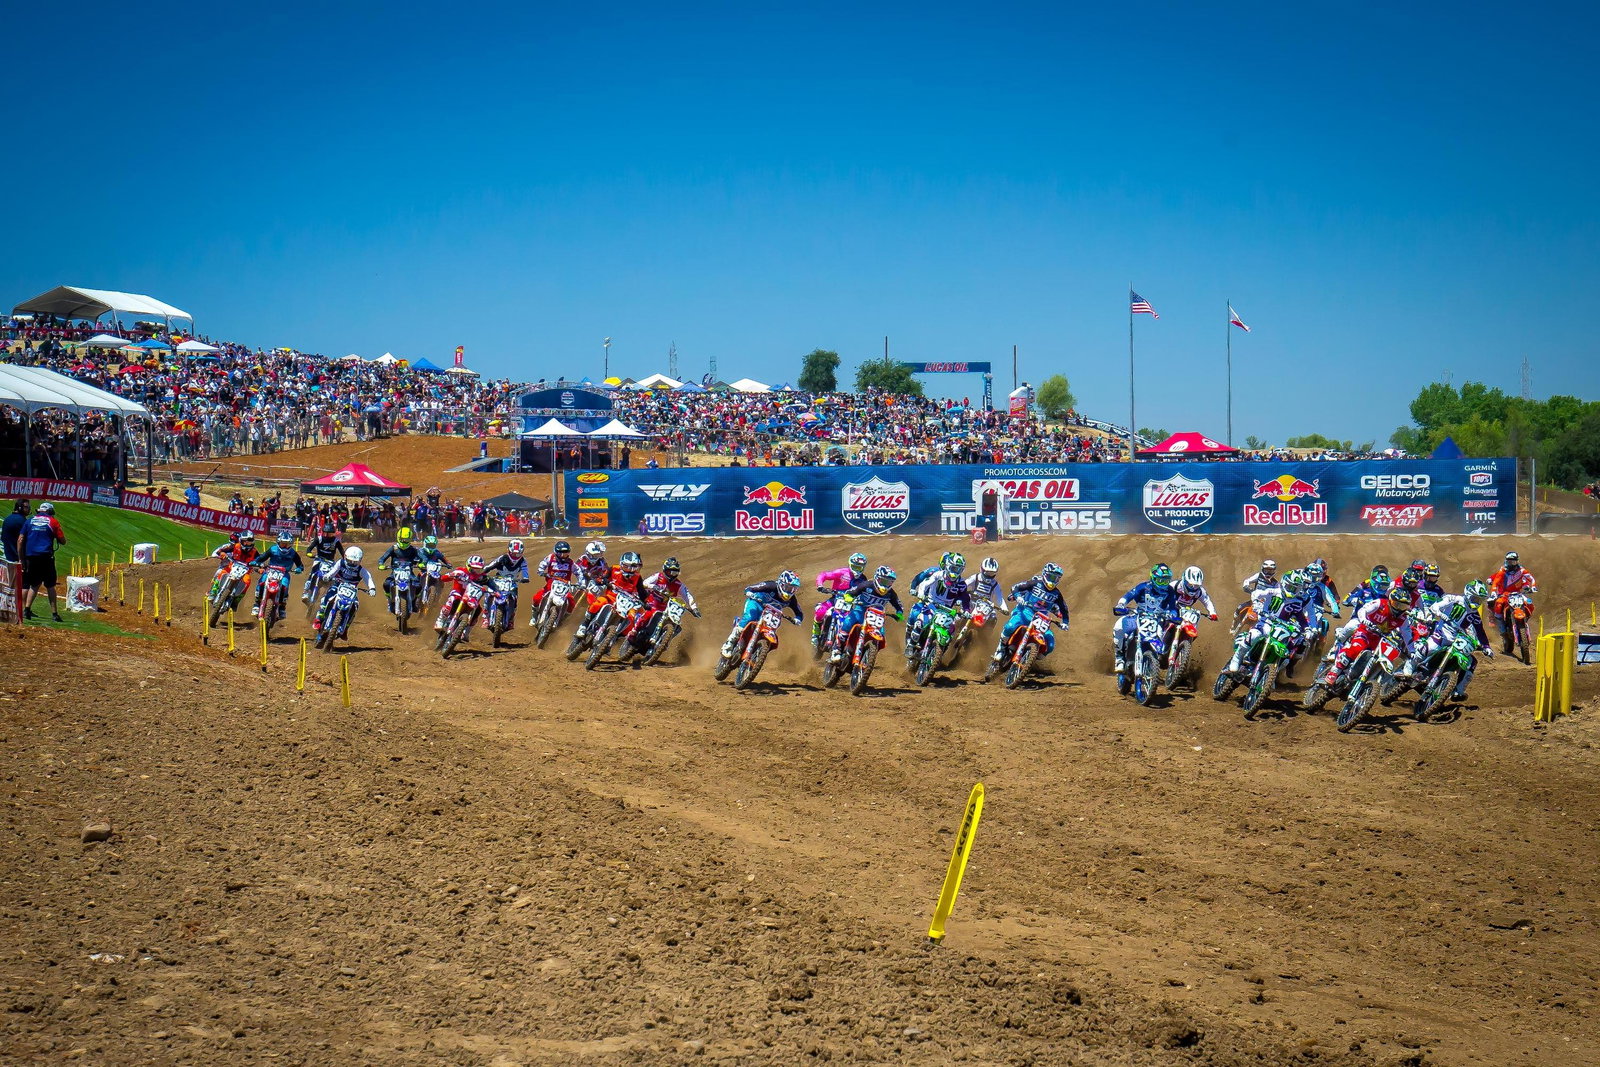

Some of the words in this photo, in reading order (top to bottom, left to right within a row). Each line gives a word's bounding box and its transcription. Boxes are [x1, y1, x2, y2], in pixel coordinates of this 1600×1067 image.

[924, 362, 952, 372] LUCAS
[954, 362, 969, 372] OIL
[984, 468, 1067, 476] PROMOTOCROSS.COM
[11, 480, 34, 495] LUCAS
[1360, 474, 1431, 489] GEICO
[47, 482, 76, 498] LUCAS
[76, 485, 89, 500] OIL
[648, 484, 711, 497] FLY
[976, 480, 1041, 499] CAS
[1044, 480, 1077, 498] OIL
[1375, 487, 1430, 499] Motorcycle
[124, 494, 150, 511] LUCAS
[151, 499, 165, 513] OIL
[850, 495, 905, 509] LUCAS
[1151, 492, 1210, 507] LUCAS
[168, 502, 198, 520] LUCAS
[200, 509, 215, 524] OIL
[735, 509, 775, 531] Red
[776, 508, 814, 531] Bull
[846, 512, 861, 520] OIL
[862, 511, 906, 519] PRODUCTS
[1165, 509, 1210, 517] PRODUCTS
[1244, 503, 1285, 526] Red
[1287, 502, 1328, 525] Bull
[1396, 506, 1433, 518] ATV
[219, 513, 249, 531] LUCAS
[250, 517, 265, 532] OIL
[644, 513, 706, 533] WPS
[868, 521, 886, 529] INC.
[941, 510, 1112, 530] MOOCROSS
[1171, 519, 1188, 527] INC.
[1371, 518, 1395, 527] ALL
[1396, 518, 1418, 526] OUT
[1032, 617, 1050, 633] 45
[1140, 618, 1157, 634] 23
[1384, 645, 1394, 657] 1
